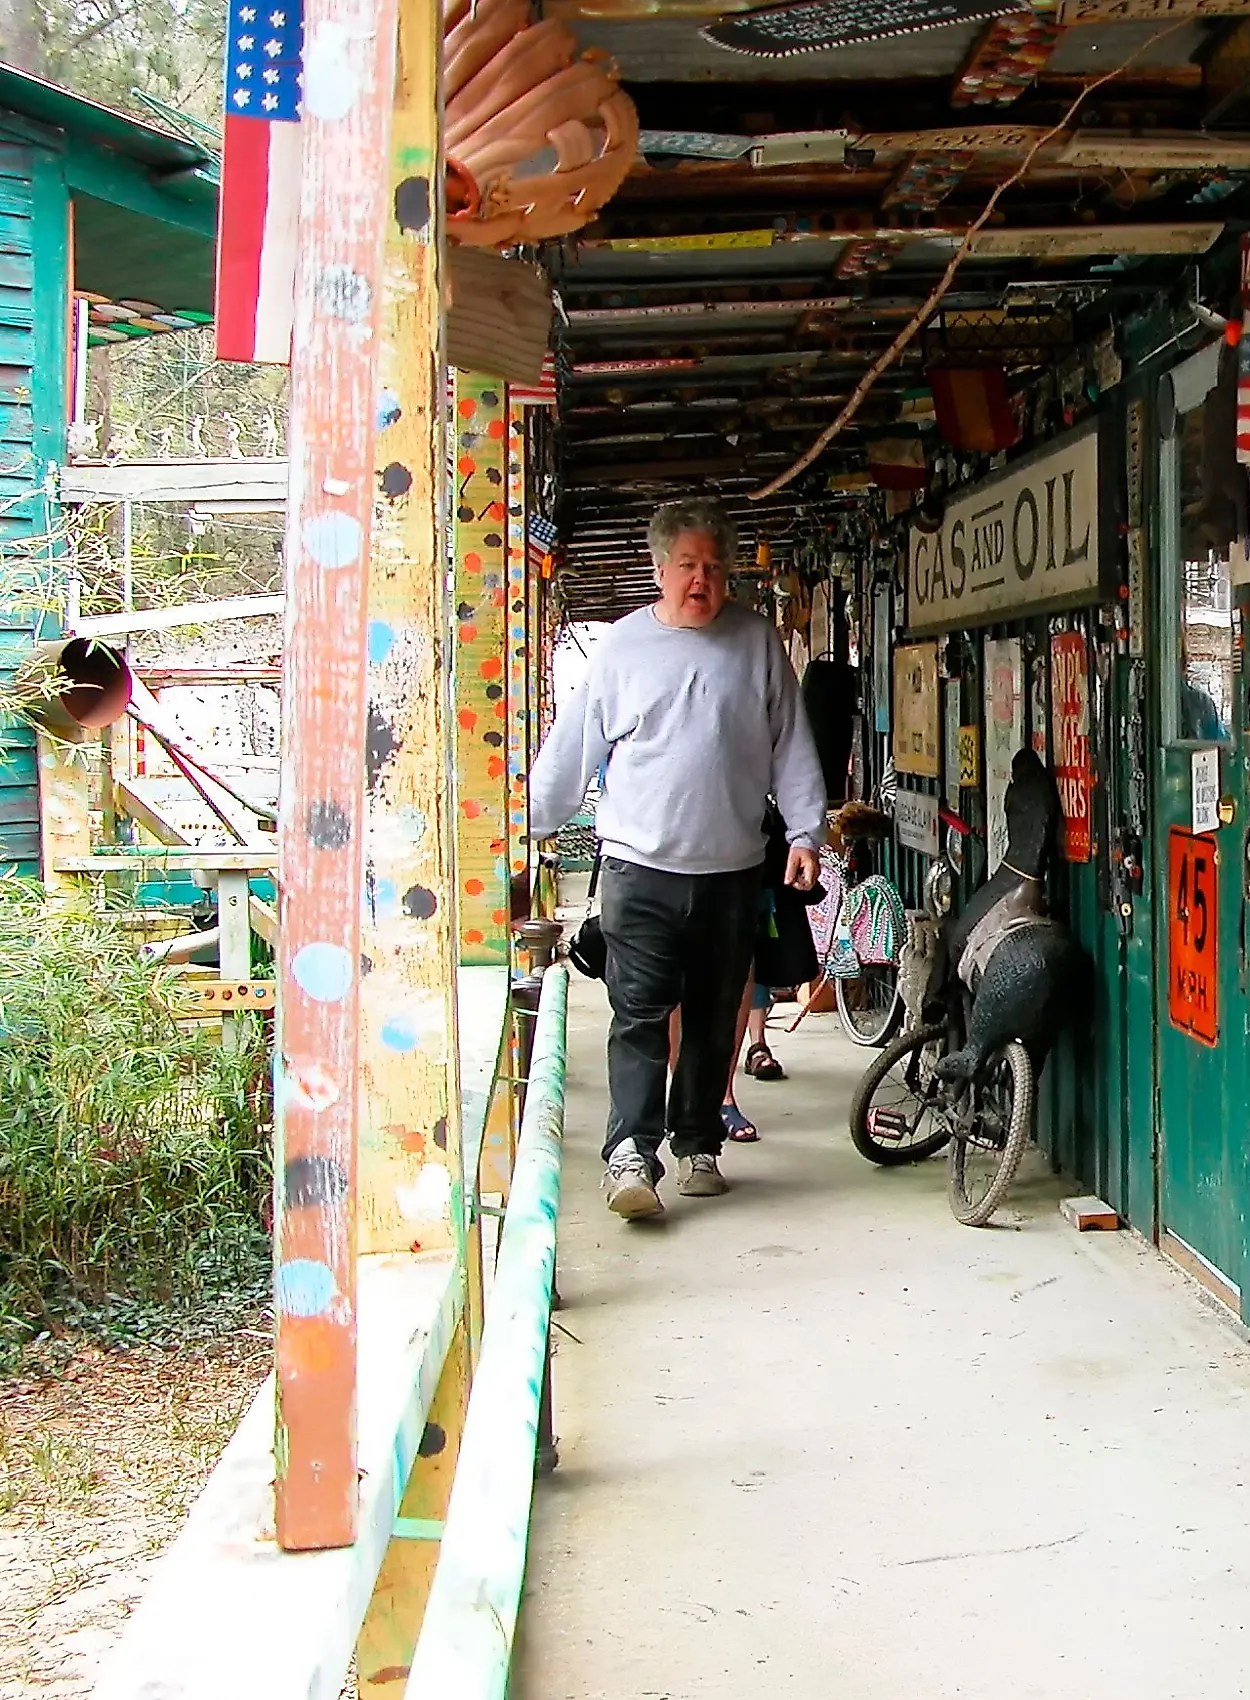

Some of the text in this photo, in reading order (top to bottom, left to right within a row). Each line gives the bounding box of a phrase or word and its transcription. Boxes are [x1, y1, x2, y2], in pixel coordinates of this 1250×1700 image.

[915, 469, 1091, 606] GAS AND OIL
[1176, 852, 1208, 953] 45
[1177, 966, 1208, 1012] MPH
